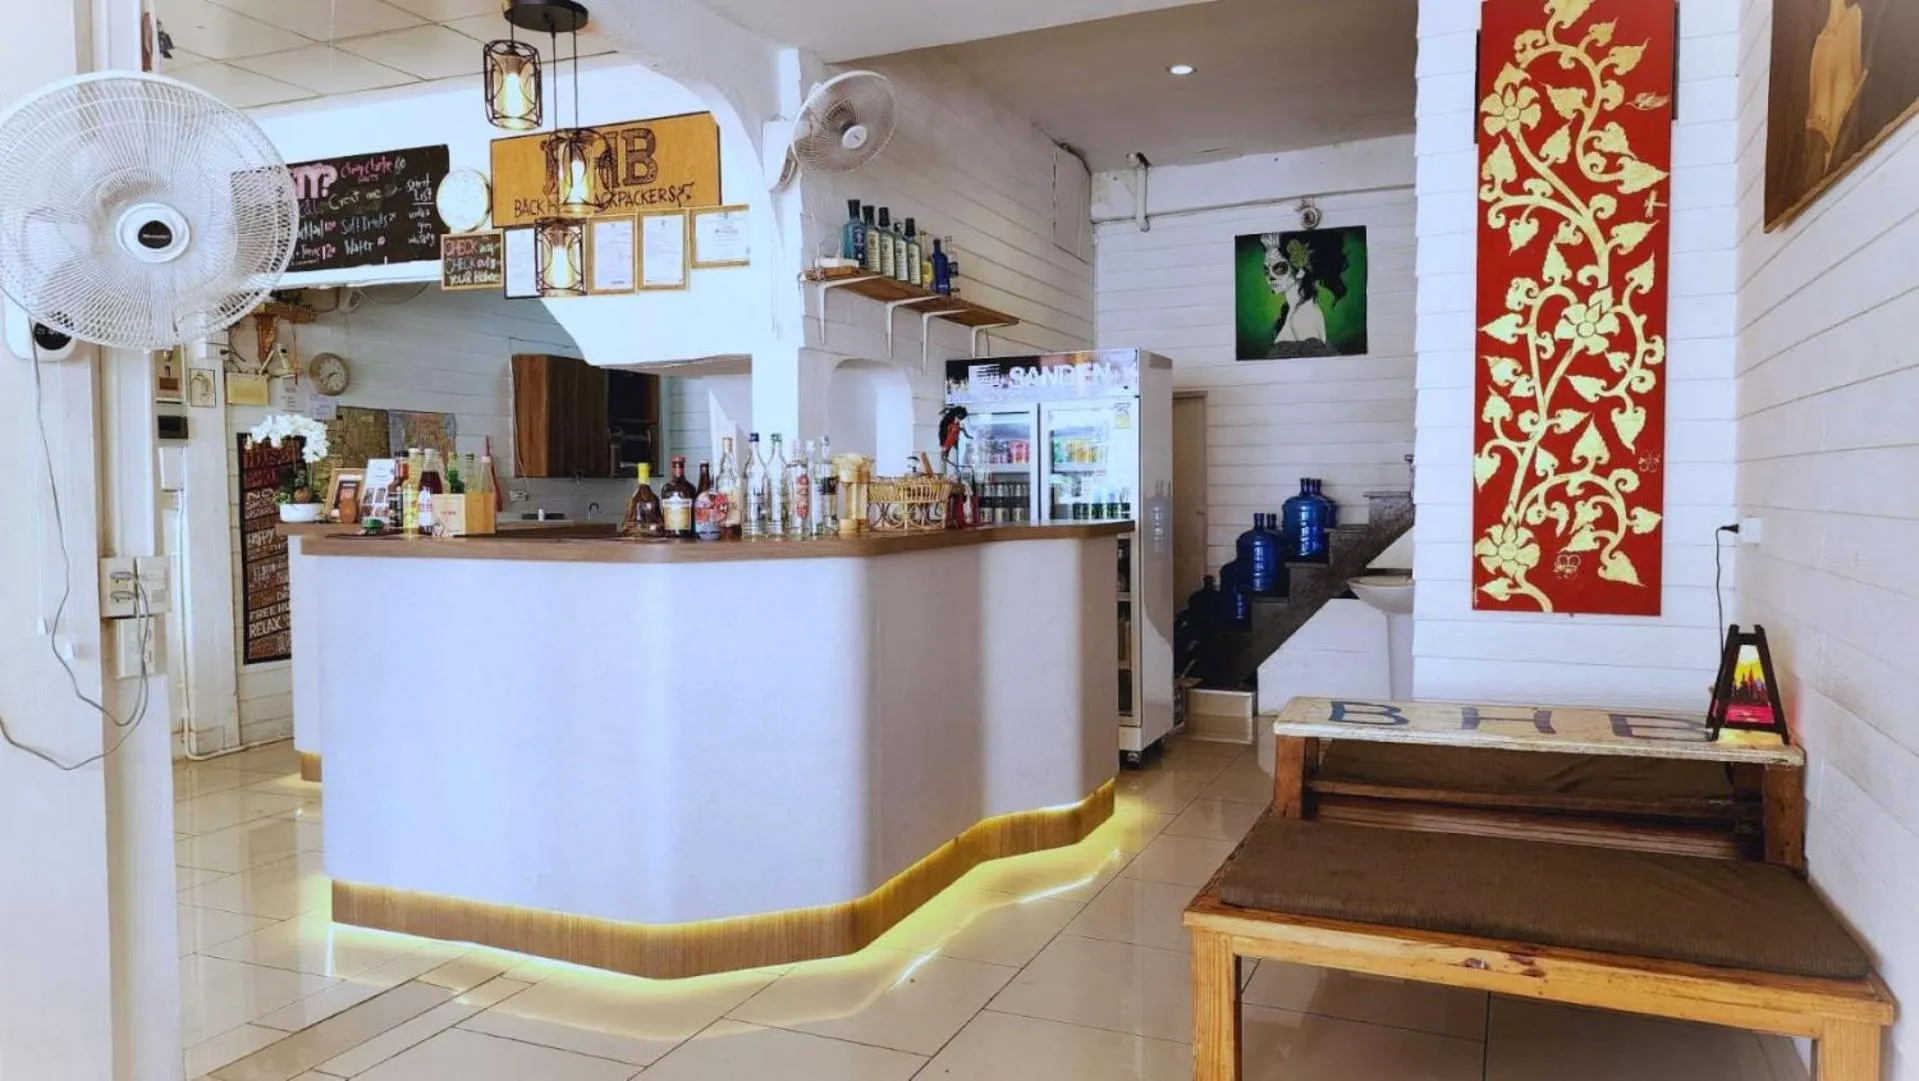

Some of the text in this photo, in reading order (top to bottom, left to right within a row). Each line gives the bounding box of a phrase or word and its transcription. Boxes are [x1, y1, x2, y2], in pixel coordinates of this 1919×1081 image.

[514, 198, 544, 217] BACK
[594, 187, 674, 209] ACKPACKERS
[1009, 361, 1112, 387] SANDEN
[249, 616, 282, 638] RELAX
